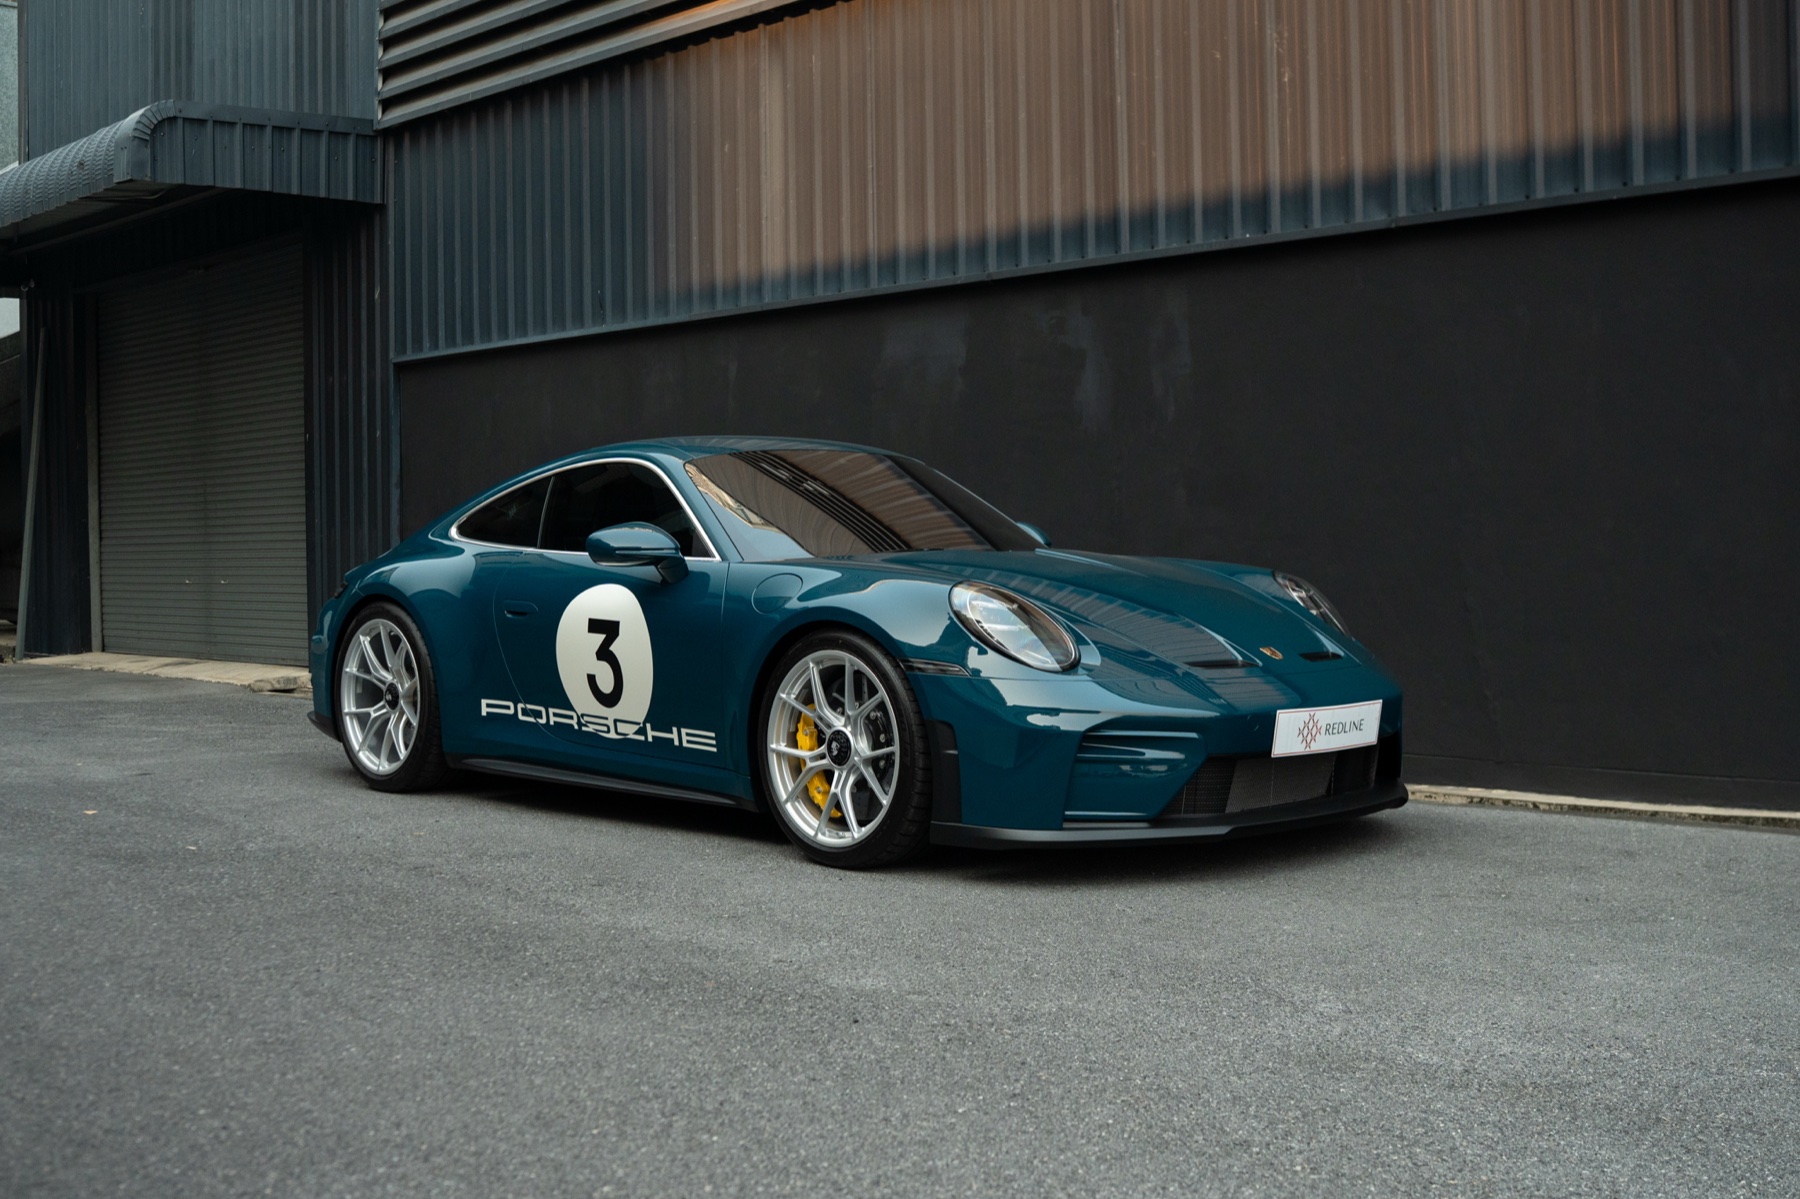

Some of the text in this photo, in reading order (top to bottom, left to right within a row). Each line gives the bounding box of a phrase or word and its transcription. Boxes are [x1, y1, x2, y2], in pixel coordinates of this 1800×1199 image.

[586, 617, 624, 709] 3
[480, 698, 717, 753] PORSCHE
[1324, 718, 1365, 736] REDLINE
